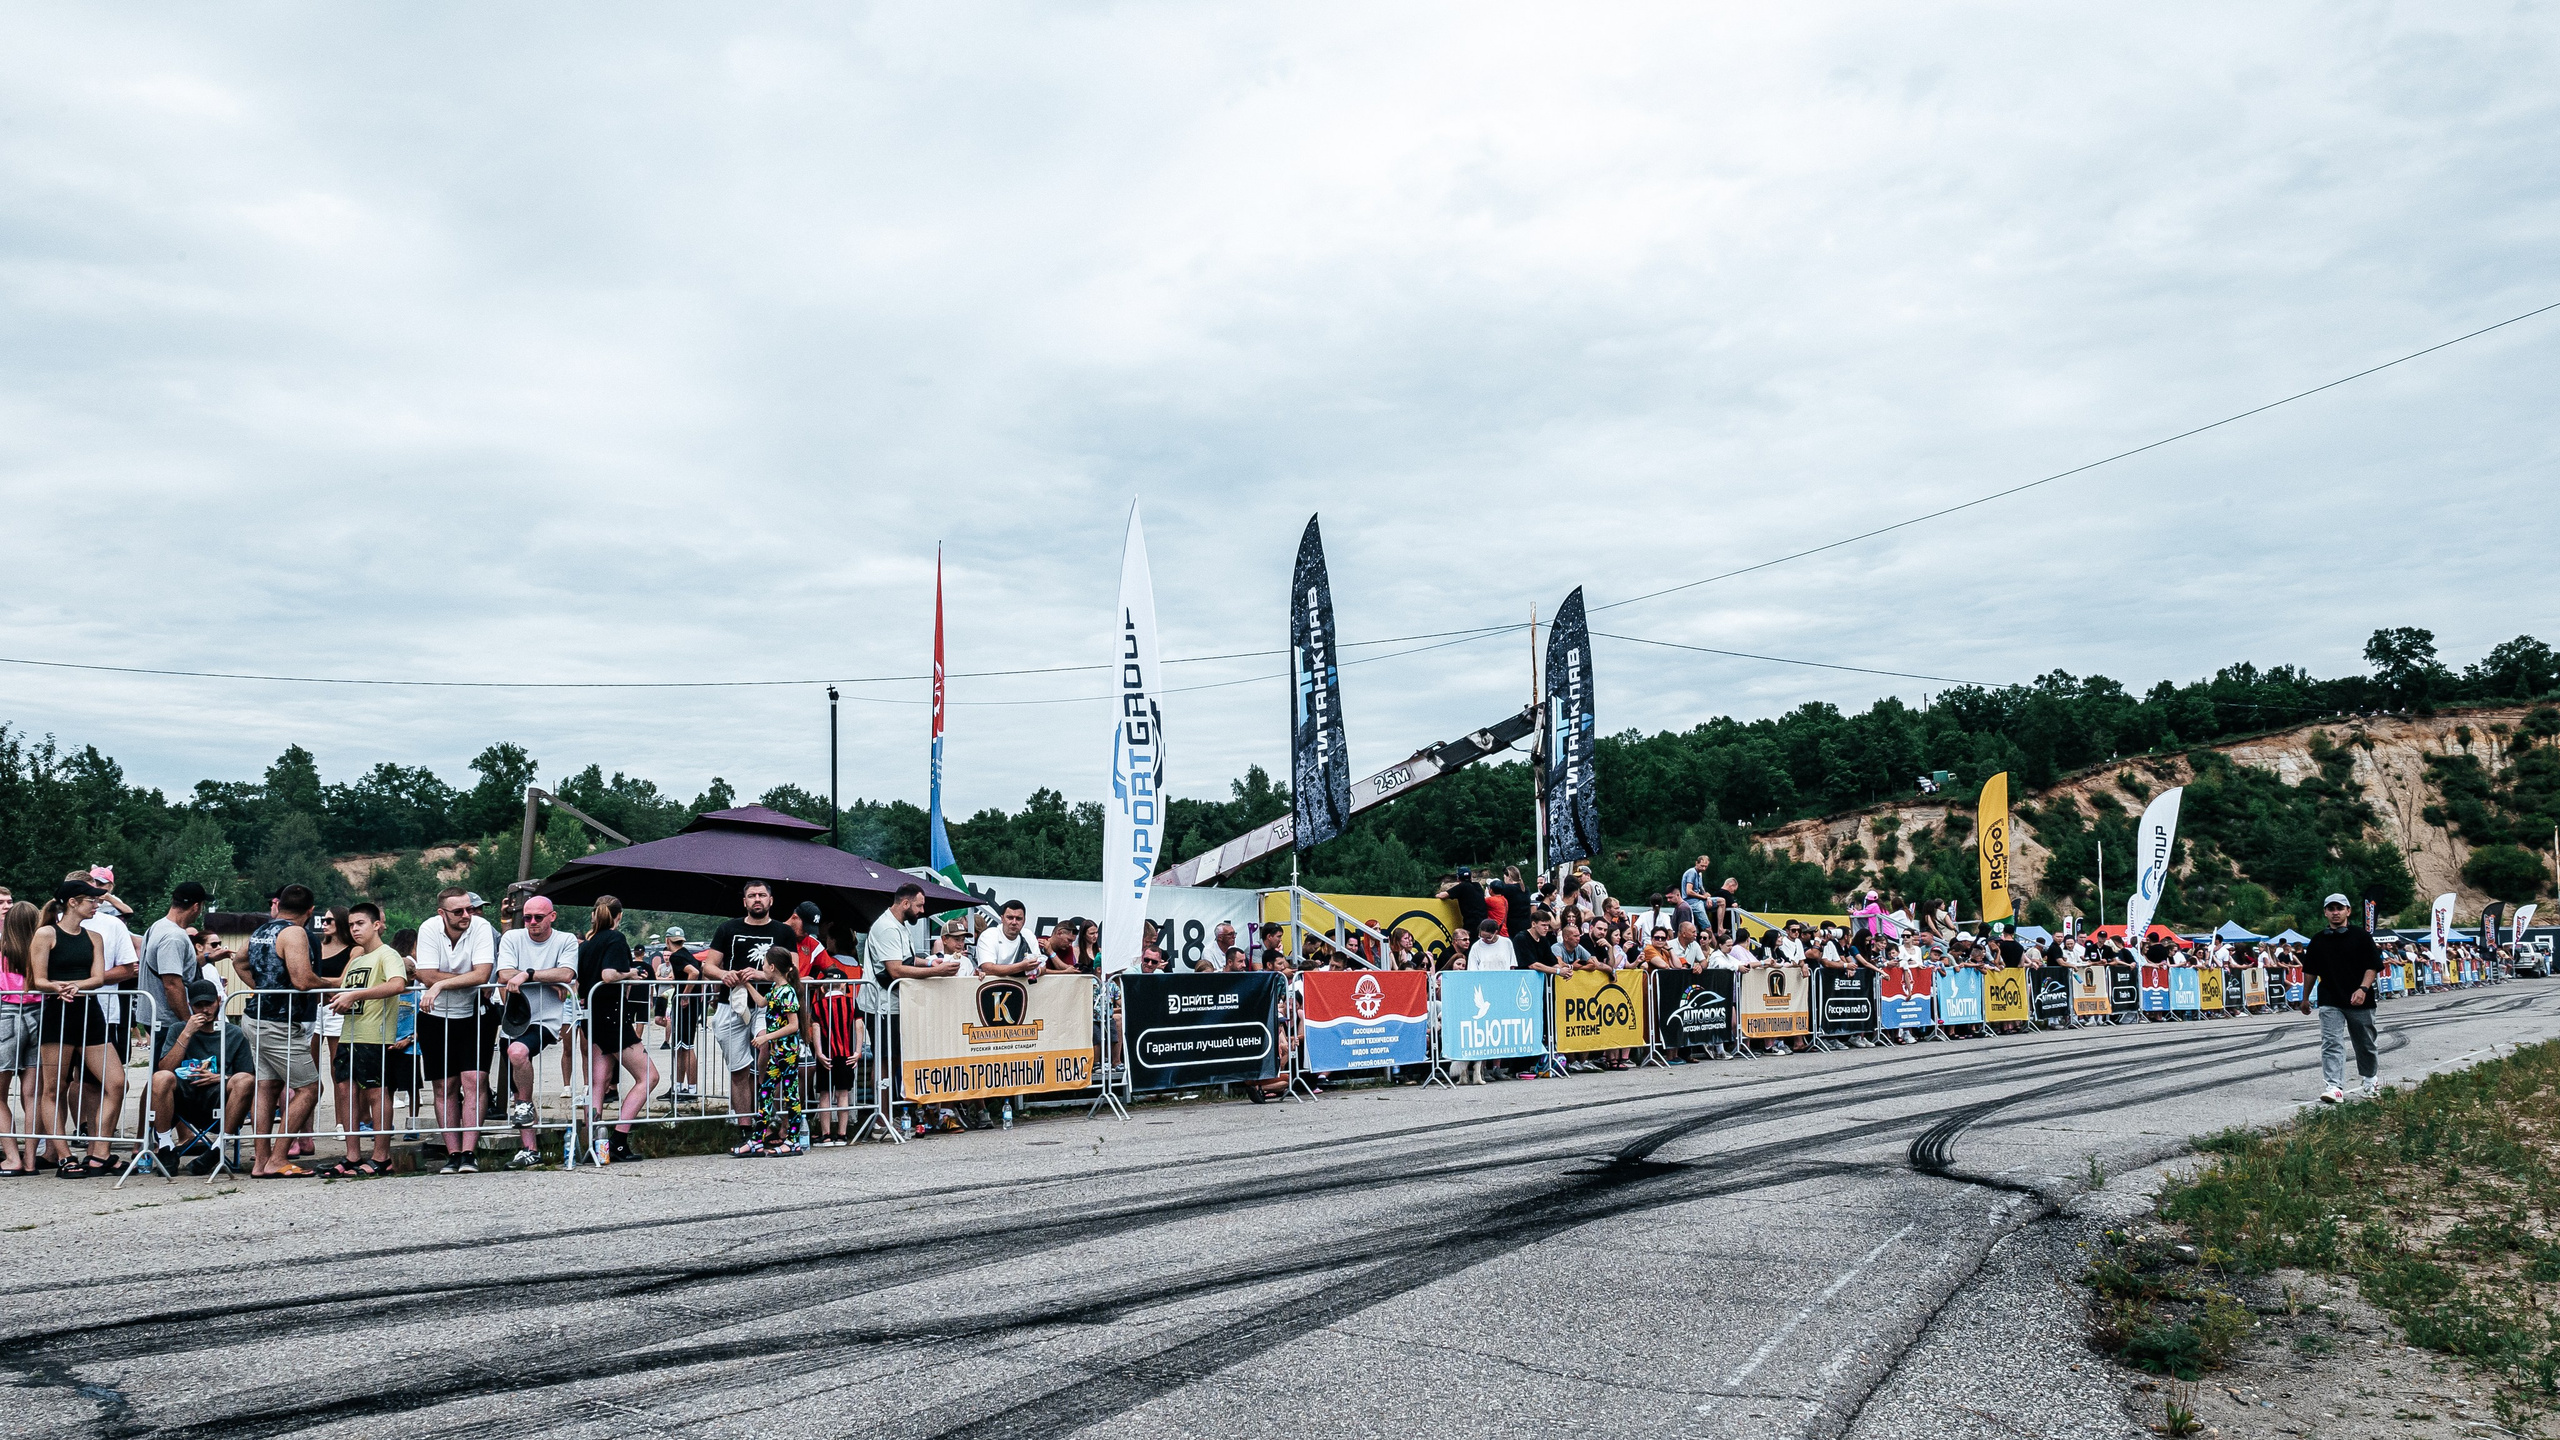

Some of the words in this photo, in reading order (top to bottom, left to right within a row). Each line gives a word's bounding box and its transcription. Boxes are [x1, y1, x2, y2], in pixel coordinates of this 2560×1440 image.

[1181, 994, 1214, 1006] ДАЙТЕ
[1218, 993, 1239, 1004] ДВА
[970, 1029, 1002, 1041] АТАМАН
[1352, 1026, 1386, 1035] АССОЦИАЦИЯ
[1460, 1018, 1533, 1049] ПЬЮТТИ
[1565, 1024, 1601, 1037] EXTREME
[1146, 1040, 1194, 1056] Гарантия
[1196, 1036, 1234, 1052] лучшей
[1236, 1036, 1262, 1048] цены
[1341, 1037, 1366, 1046] РАЗВИТИЯ
[1366, 1036, 1400, 1044] ТЕХНИЧЕСКИХ
[1352, 1048, 1369, 1056] ВИДОВ
[1370, 1047, 1390, 1055] СПОРТА
[1348, 1059, 1374, 1068] АМУРСКОЙ
[914, 1056, 1045, 1096] НЕФИЛЬТРОВАННЫЙ
[1055, 1056, 1088, 1084] КВАС
